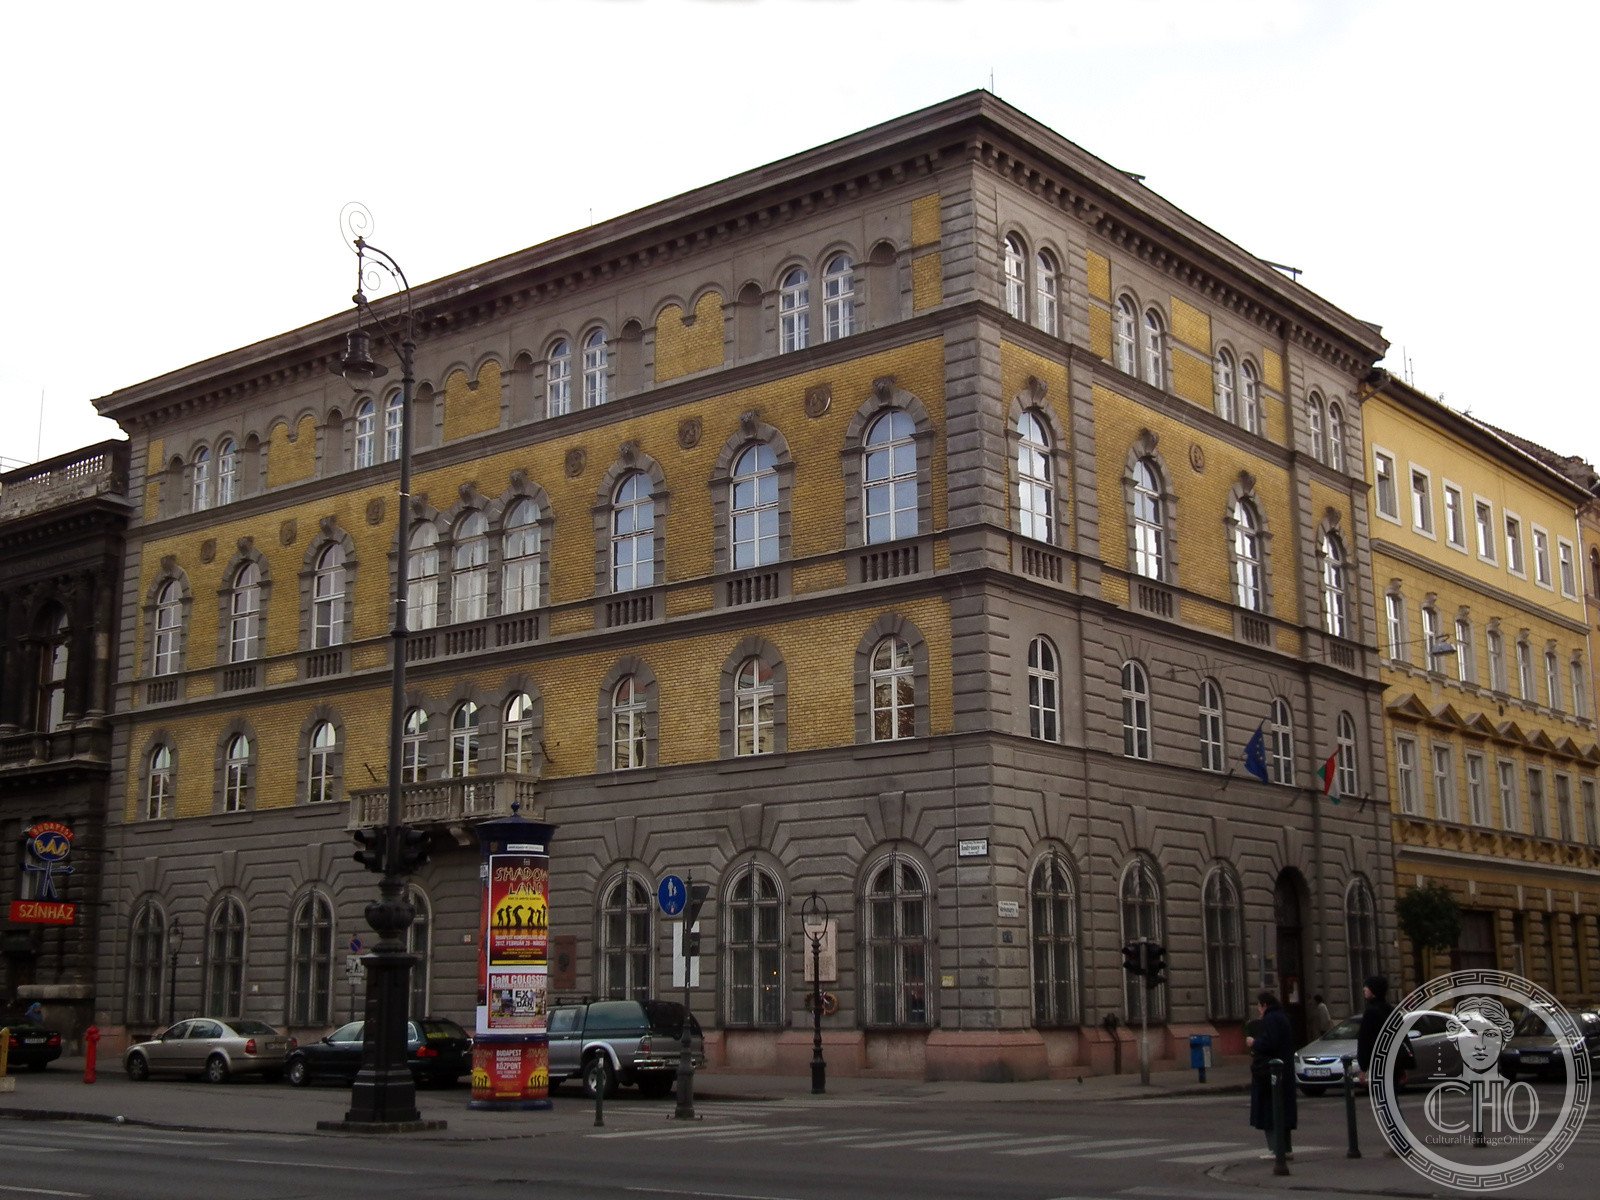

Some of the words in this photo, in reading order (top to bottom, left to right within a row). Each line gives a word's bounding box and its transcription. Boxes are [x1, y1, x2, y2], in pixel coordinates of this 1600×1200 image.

[508, 882, 543, 895] LAND
[18, 902, 74, 920] SZÍNHÁZ
[496, 1049, 521, 1057] BUDAPEST
